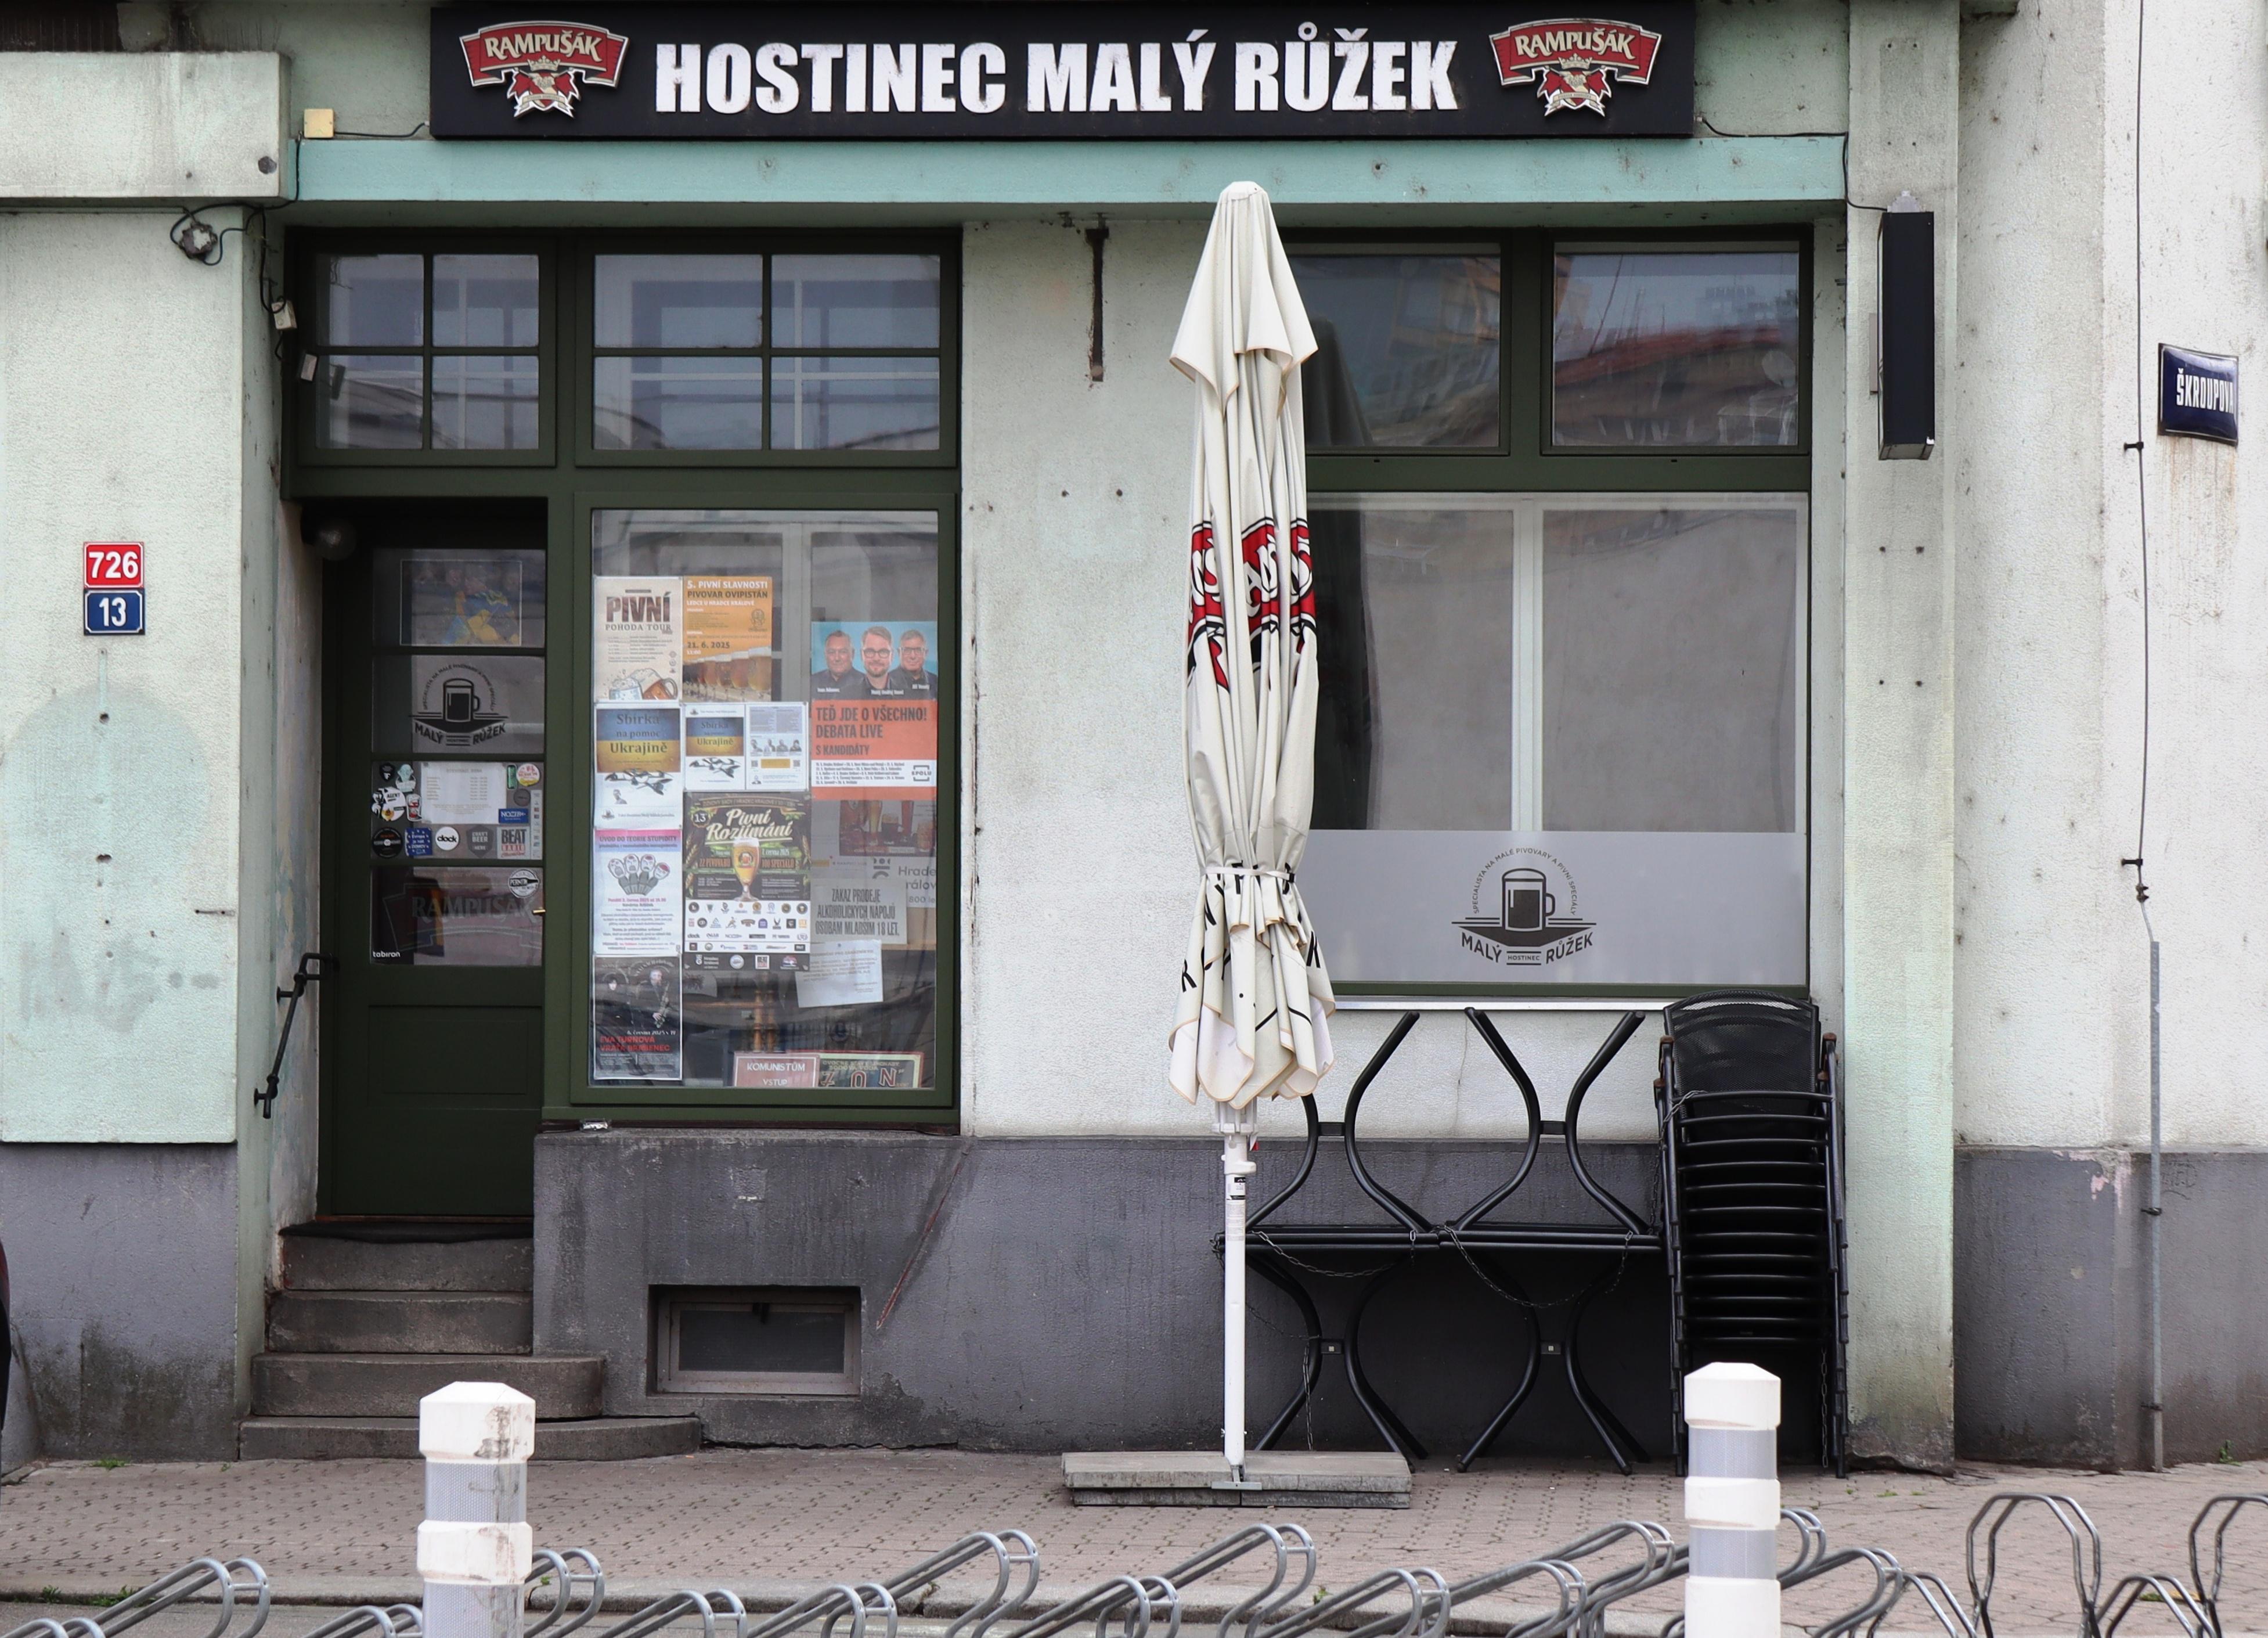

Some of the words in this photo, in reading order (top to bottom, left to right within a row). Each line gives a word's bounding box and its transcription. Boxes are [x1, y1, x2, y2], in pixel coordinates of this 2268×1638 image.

[484, 30, 603, 62] RAMPUŠÁK
[1515, 27, 1636, 60] RAMPUŠÁK
[656, 43, 1007, 114] HOSTINEC
[1027, 28, 1217, 112] MALÝ
[1235, 21, 1458, 111] RŮŽEK
[2176, 368, 2234, 414] ŠKROUPOVA
[89, 551, 139, 579] 726
[687, 581, 696, 589] 5.
[698, 579, 720, 589] PIVNÍ
[723, 581, 768, 589] SLAVNOSTI
[687, 591, 723, 599] PIVOVAR
[99, 597, 127, 627] 13
[606, 591, 672, 623] PIVNÍ
[605, 624, 644, 632] POHODA
[646, 624, 672, 632] TOUR
[816, 704, 836, 721] TEĎ
[839, 707, 859, 721] JDE
[861, 707, 870, 721] O
[872, 704, 927, 722] VŠECHNO!
[414, 722, 443, 744] MALÝ
[473, 722, 506, 745] RŮŽEK
[629, 730, 661, 739] pomoc
[816, 725, 857, 739] DEBATA
[860, 725, 884, 738] LIVE
[610, 743, 668, 755] Ukrajině
[816, 745, 821, 755] S
[823, 743, 870, 755] KANDIDÁTY
[726, 808, 772, 826] Pivní
[502, 829, 527, 844] BEAT
[898, 866, 936, 877] Hrade
[906, 881, 936, 890] rálov
[1472, 870, 1487, 914] SPECIALISTA
[1485, 860, 1495, 870] NA
[1495, 848, 1514, 862] MALÉ
[1516, 847, 1552, 859] PIVOVARY
[1557, 862, 1571, 880] PIVNÍ
[1568, 881, 1578, 916] SPECIÁLY
[852, 888, 881, 902] PRODEJE
[817, 902, 868, 919] ALKOHOLICKÝCH
[870, 902, 896, 919] NÁPOJŮ
[844, 917, 875, 935] MLADŠÍM
[877, 922, 886, 936] 18
[888, 922, 900, 936] LET.
[1461, 931, 1502, 963] MALÝ
[1545, 931, 1593, 964] RŮŽEK
[747, 1060, 806, 1071] KOMUNISTŮM
